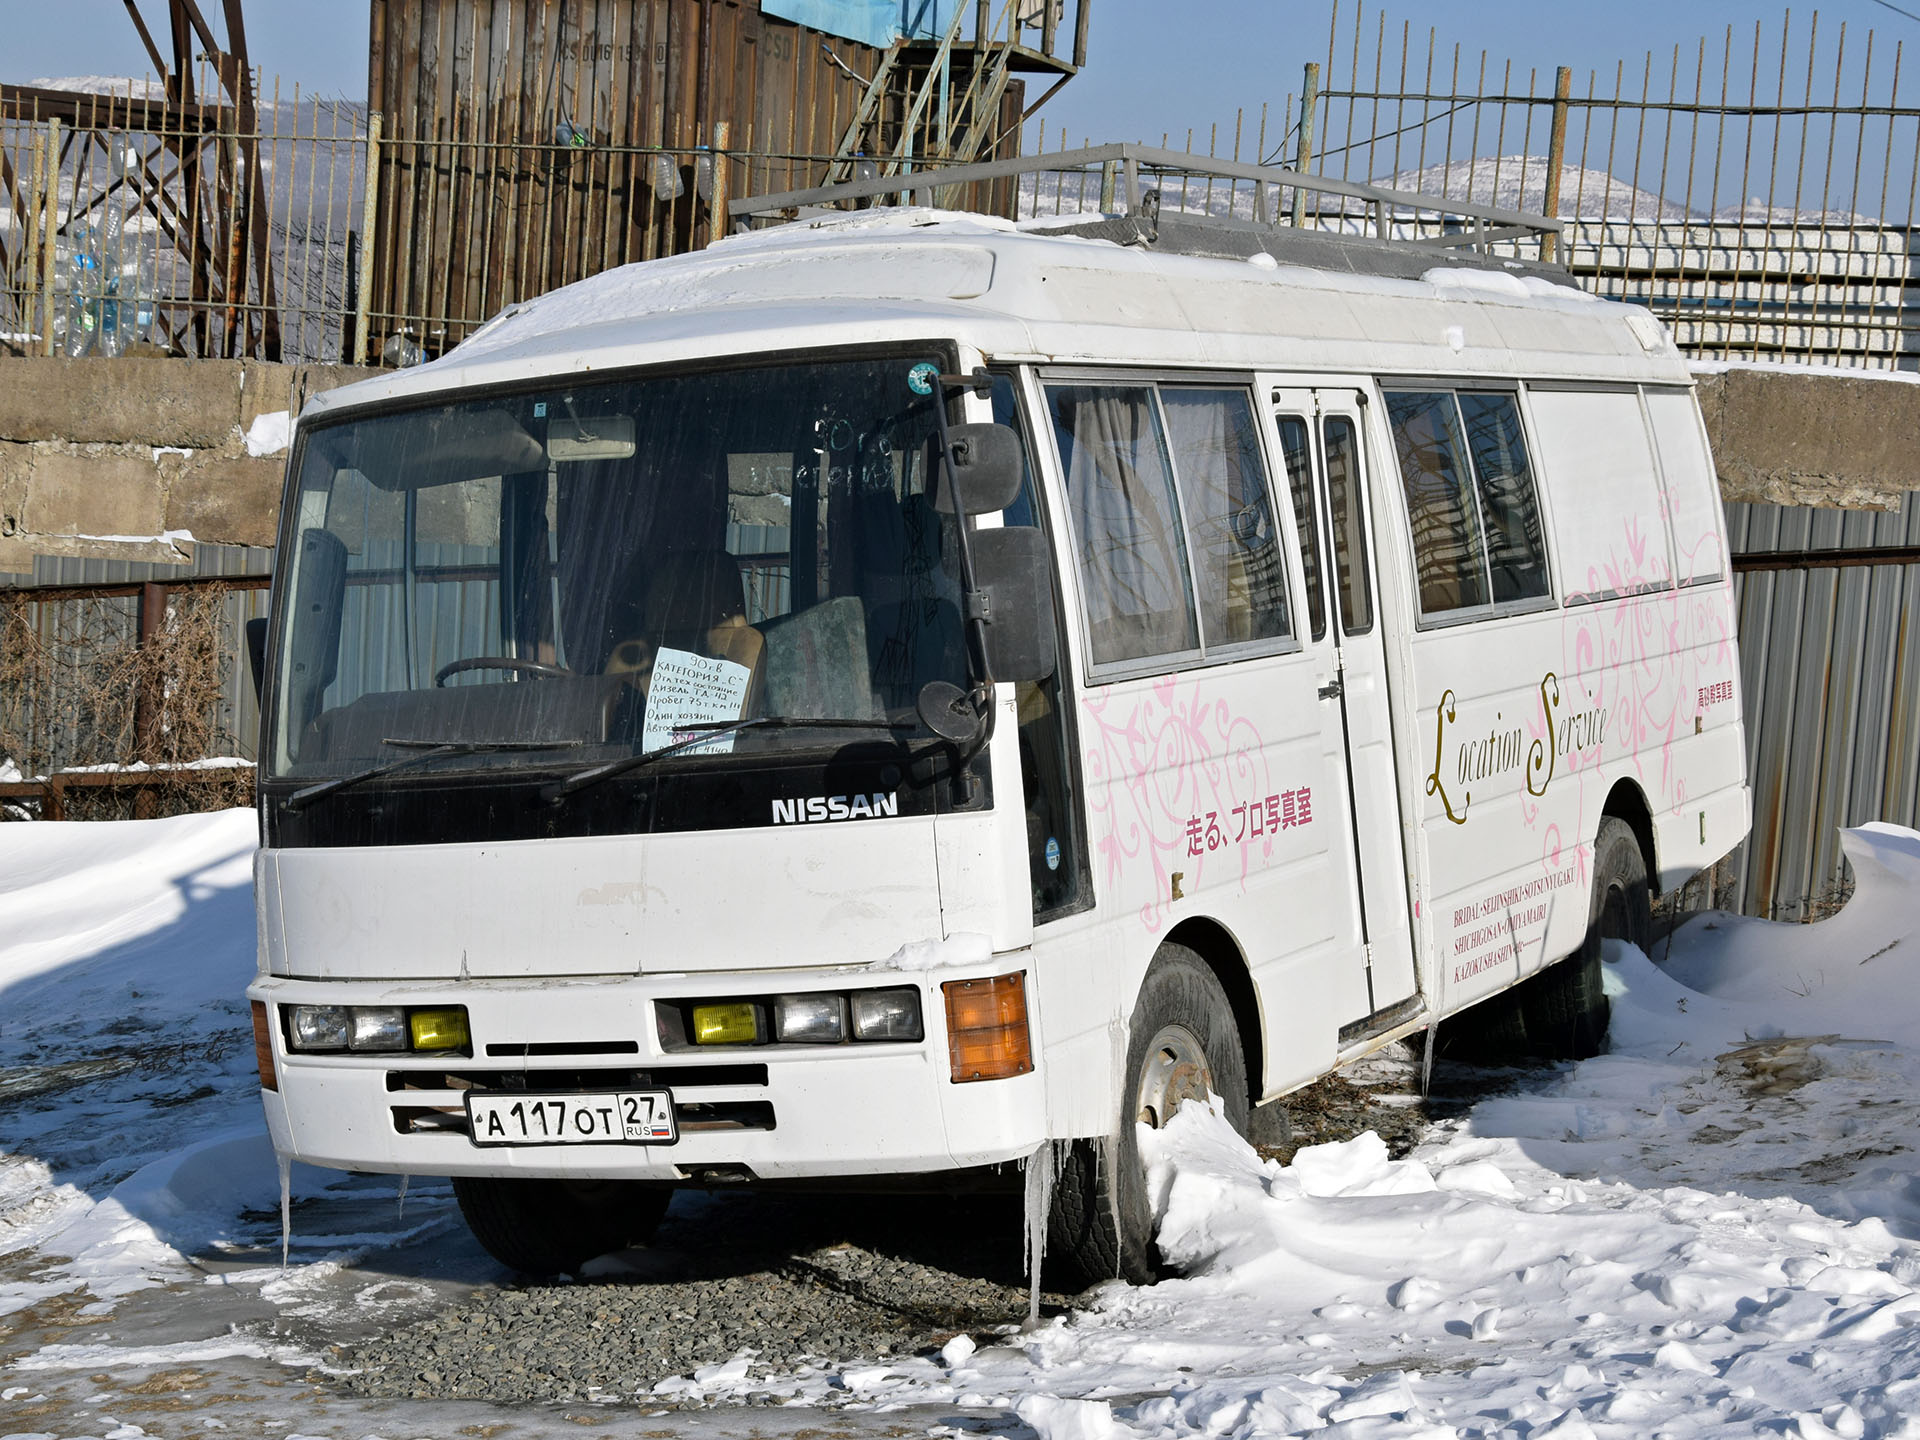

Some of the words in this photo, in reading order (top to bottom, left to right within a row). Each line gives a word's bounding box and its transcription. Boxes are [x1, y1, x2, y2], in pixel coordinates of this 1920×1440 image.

[657, 661, 719, 683] КАТЕГОРИЯ
[647, 709, 673, 721] Один
[678, 713, 714, 721] хозяин
[1426, 689, 1522, 825] Location
[1526, 671, 1608, 797] Service
[771, 791, 898, 824] NISSAN
[1186, 786, 1313, 858] 走る、プロ写真室
[623, 1097, 655, 1124] 27
[626, 1126, 650, 1136] RUS
